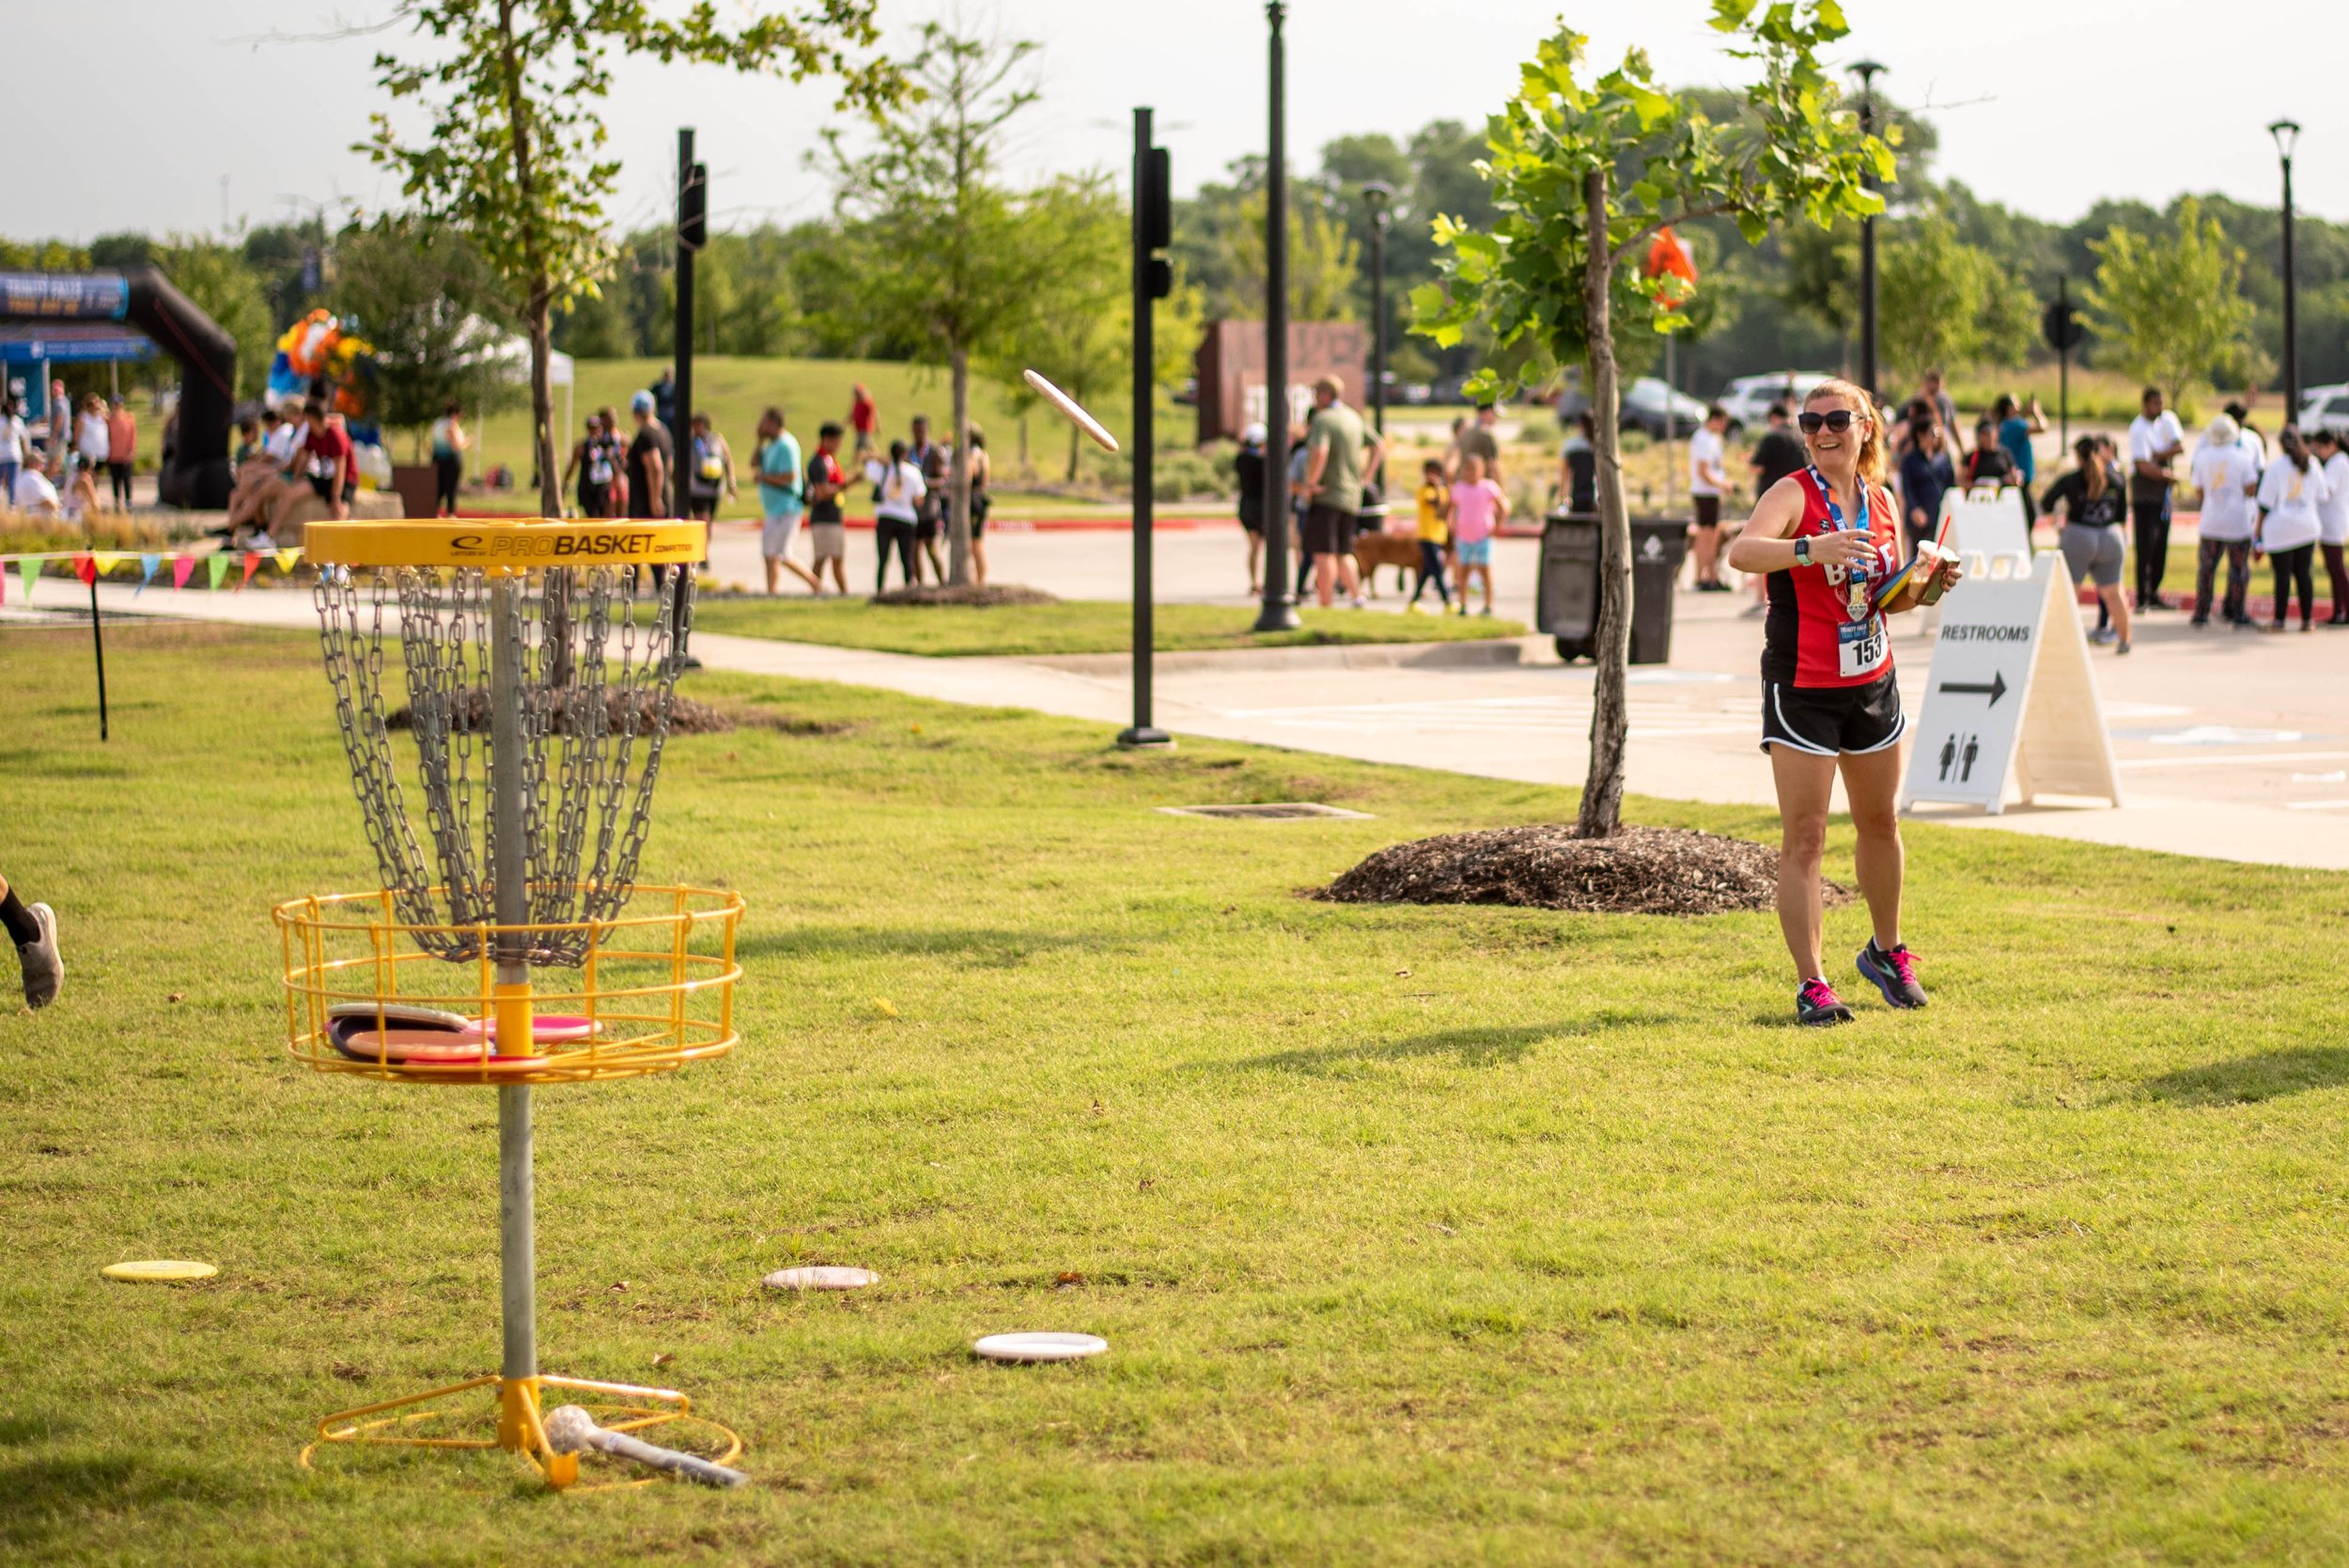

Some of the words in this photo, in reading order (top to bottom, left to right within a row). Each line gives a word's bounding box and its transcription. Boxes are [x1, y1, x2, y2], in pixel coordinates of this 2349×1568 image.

[490, 534, 656, 557] PROBASKET
[1824, 543, 1894, 587] BEF
[1940, 624, 2030, 642] RESTROOMS
[1852, 634, 1882, 666] 153
